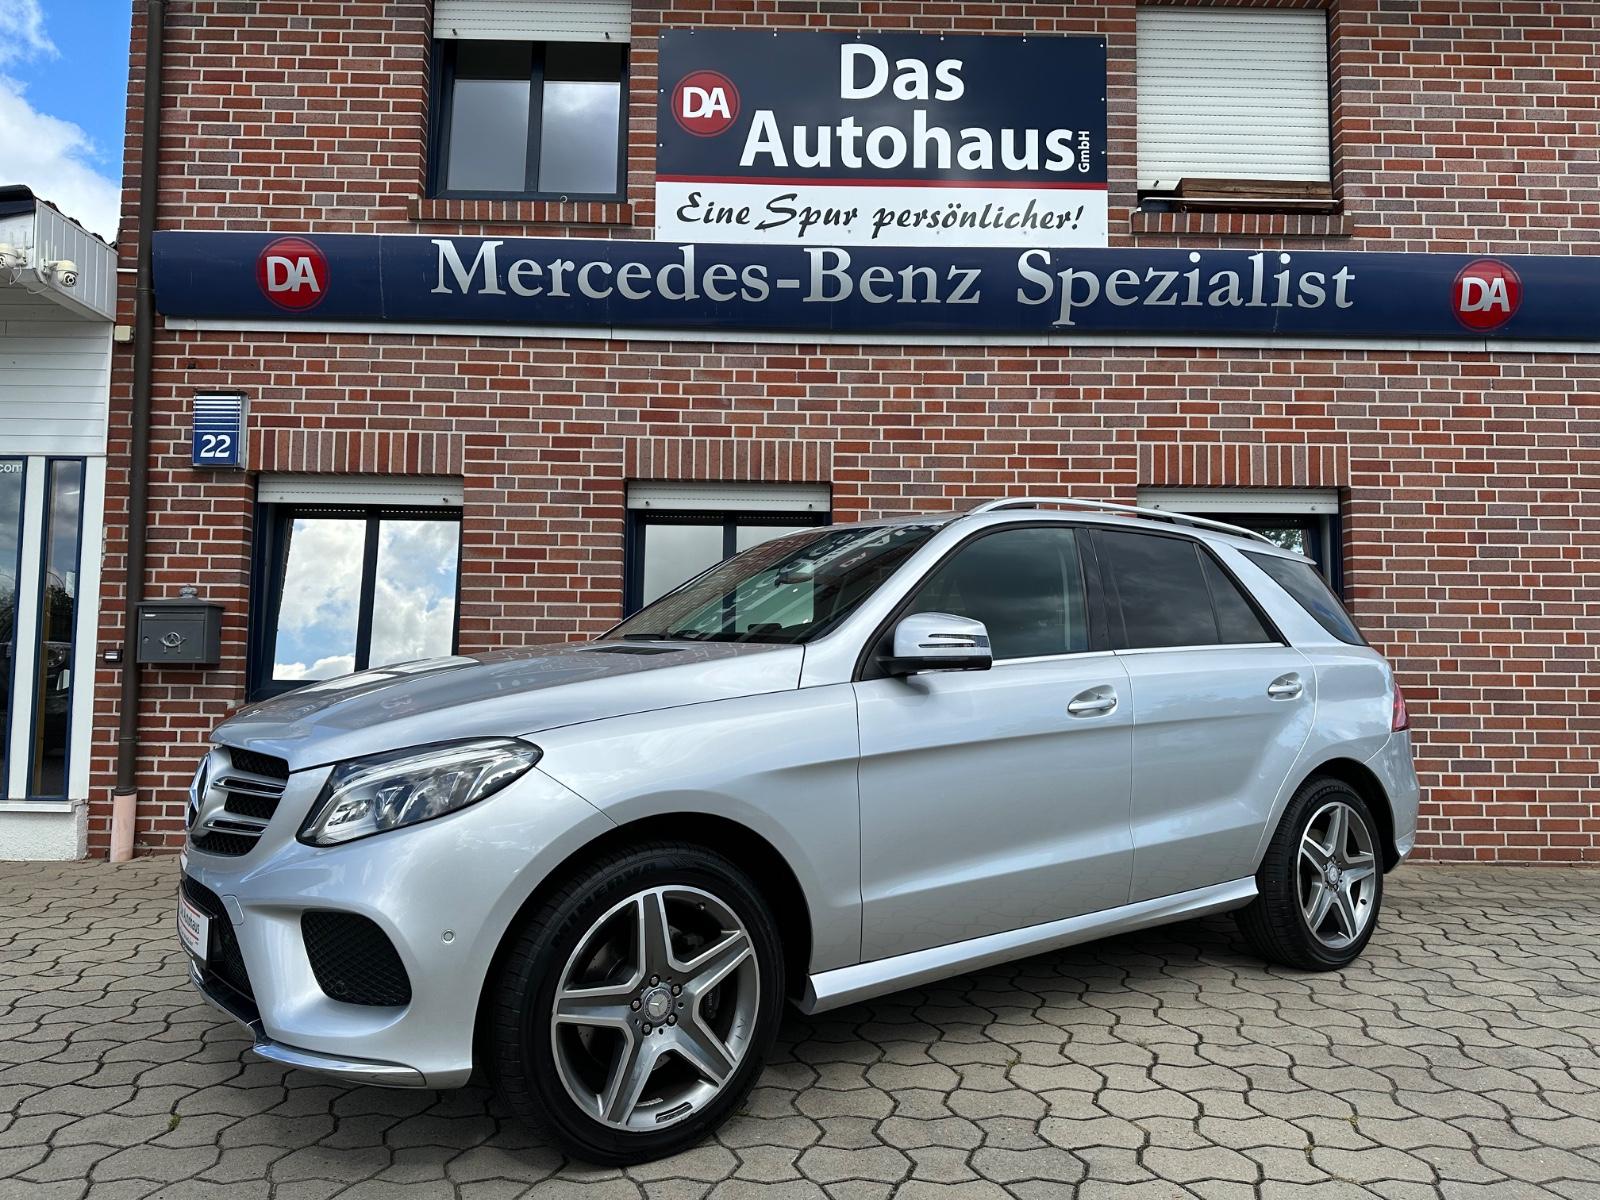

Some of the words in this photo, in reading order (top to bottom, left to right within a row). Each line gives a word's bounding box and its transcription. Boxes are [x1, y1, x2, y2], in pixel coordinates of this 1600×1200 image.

[840, 43, 965, 102] Das
[682, 86, 732, 119] DA
[739, 109, 1075, 172] Autohaus
[1078, 130, 1090, 173] GmbH
[676, 191, 751, 225] Eine
[754, 193, 858, 239] Spur
[871, 198, 1084, 240] persönlicher!
[266, 255, 320, 292] DA
[430, 238, 982, 304] Mercedes-Benz
[1017, 248, 1356, 326] Spezialist
[1460, 276, 1510, 312] DA
[200, 434, 231, 458] 22
